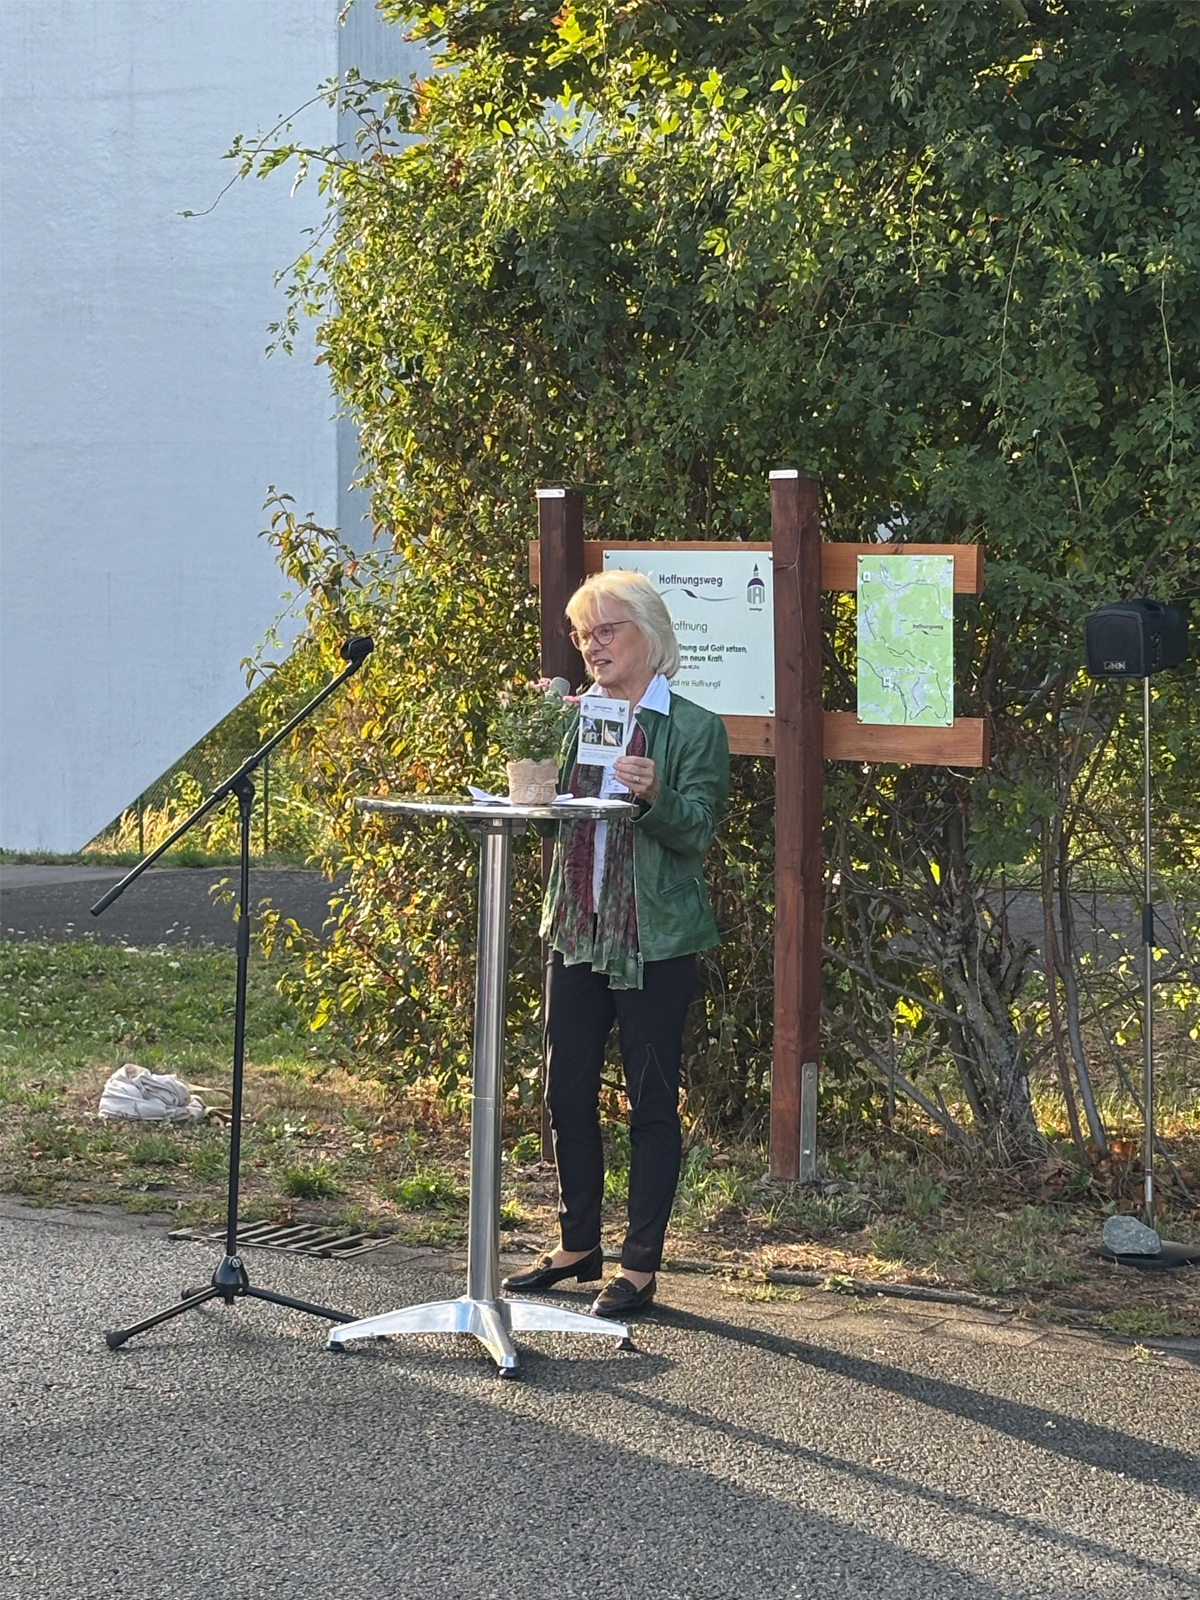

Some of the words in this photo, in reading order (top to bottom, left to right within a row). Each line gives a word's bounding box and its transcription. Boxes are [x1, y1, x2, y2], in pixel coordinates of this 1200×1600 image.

[658, 574, 723, 587] Hoffnungsweg
[698, 644, 709, 652] auf
[710, 644, 725, 652] Gott
